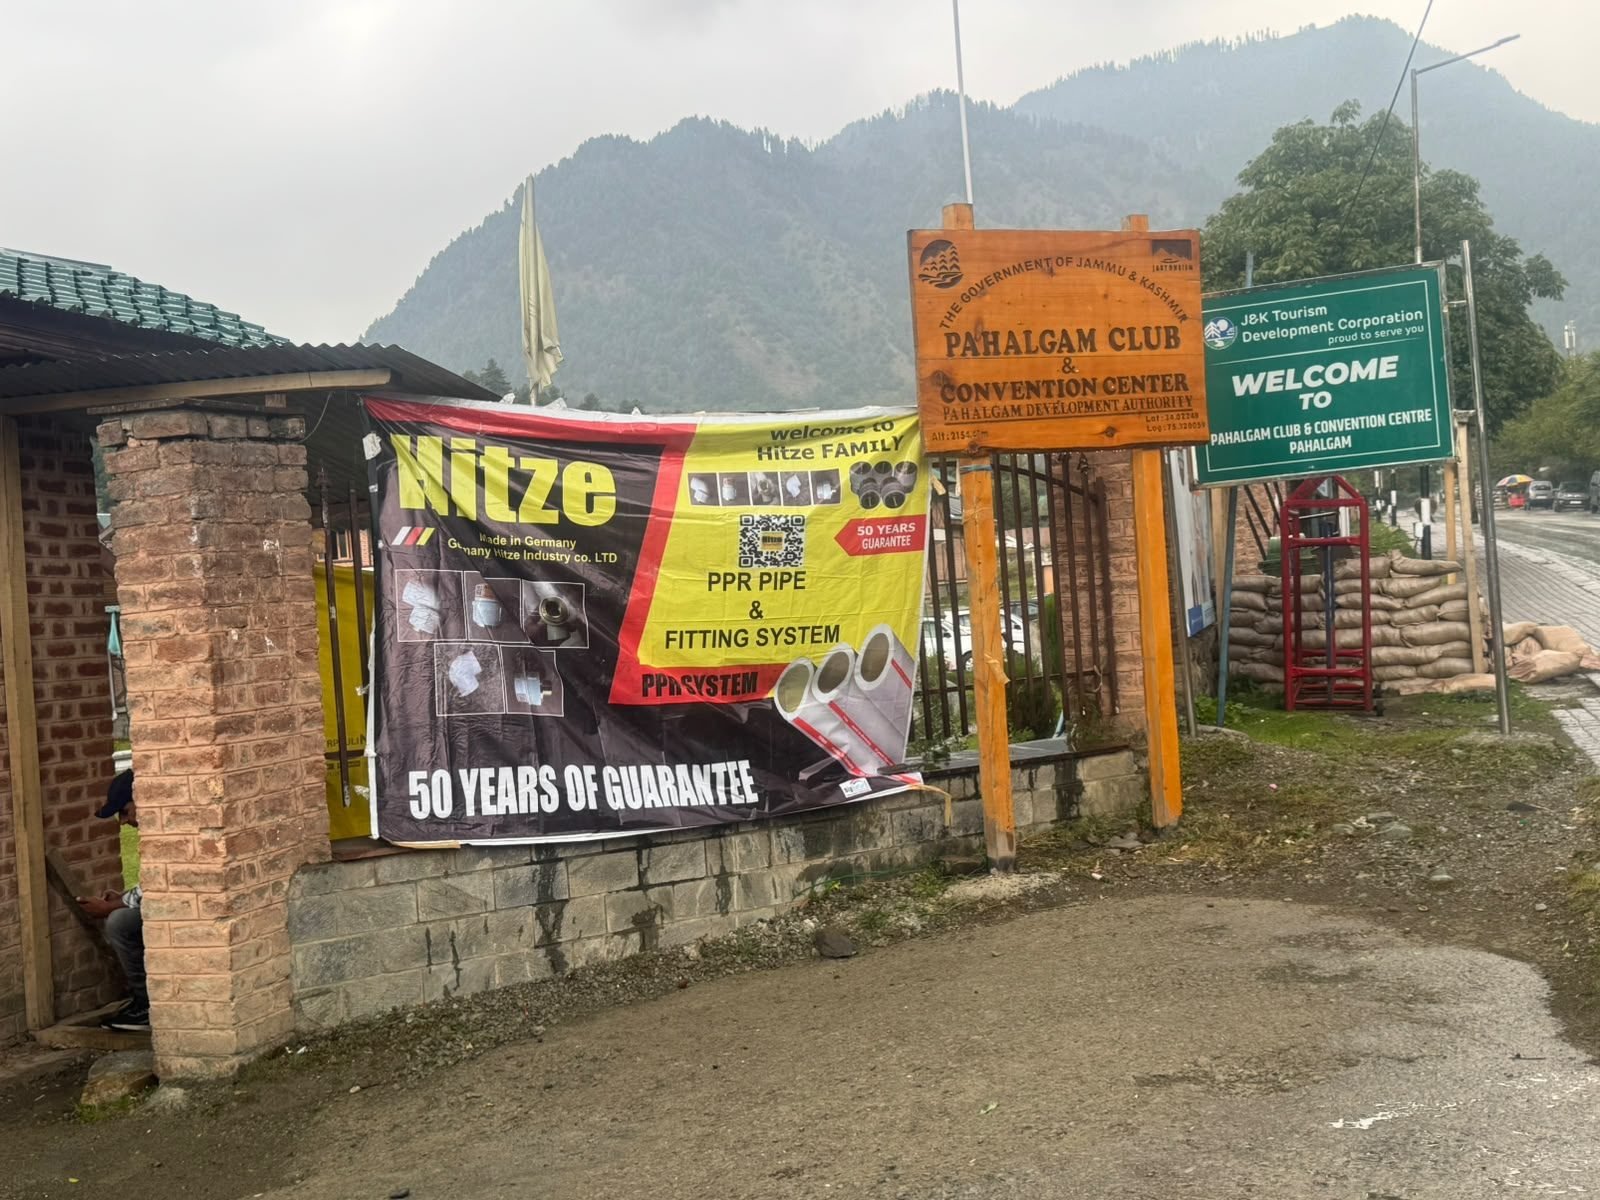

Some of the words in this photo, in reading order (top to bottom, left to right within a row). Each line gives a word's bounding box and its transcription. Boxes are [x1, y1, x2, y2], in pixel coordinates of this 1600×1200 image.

[939, 303, 962, 330] THE
[960, 257, 1053, 303] GOVERNMENT
[1055, 256, 1073, 267] OF
[1076, 257, 1127, 277] JAMMU
[1128, 271, 1137, 281] &
[1139, 276, 1189, 323] KASHMIR
[1241, 311, 1269, 326] J&K
[1272, 305, 1327, 323] Tourism
[1242, 321, 1334, 343] Development
[1338, 310, 1423, 332] Corporation
[943, 328, 1098, 358] PAHALGAM
[1108, 325, 1181, 351] CLUB
[1328, 332, 1358, 346] proud
[1360, 330, 1372, 340] to
[1375, 327, 1402, 339] serve
[1405, 324, 1424, 337] you
[1062, 356, 1076, 374] &
[1232, 355, 1399, 397] WELCOME
[940, 378, 1098, 403] CONVENTION
[1103, 373, 1189, 395] CENTER
[943, 405, 1022, 421] PAHALGAM
[1027, 399, 1119, 417] DEVELOPMENT
[1123, 395, 1193, 410] AUTHORITY
[1299, 391, 1332, 410] TO
[771, 421, 865, 441] welcome
[873, 419, 895, 432] to
[1210, 427, 1271, 446] PAHALGAM
[1273, 423, 1301, 439] CLUB
[1304, 422, 1311, 434] &
[1314, 414, 1386, 434] CONVENTION
[1388, 408, 1432, 426] CENTRE
[757, 446, 815, 461] Hitze
[822, 435, 905, 460] FAMILY
[1289, 435, 1352, 454] PAHALGAM
[390, 434, 617, 526] Hitze
[857, 525, 874, 536] 50
[877, 522, 916, 534] YEARS
[480, 533, 507, 545] Made
[510, 535, 521, 545] in
[524, 536, 576, 550] Germany
[862, 536, 911, 550] GUARANTEE
[494, 550, 520, 560] Hitze
[524, 550, 570, 564] Industry
[574, 554, 591, 563] co.
[595, 553, 617, 563] LTD
[707, 571, 752, 592] PPR
[758, 570, 807, 591] PIPE
[748, 600, 764, 619] &
[665, 628, 750, 650] FITTING
[756, 624, 840, 647] SYSTEM
[681, 671, 759, 697] SYSTEM
[408, 769, 453, 820] 50
[459, 765, 560, 816] YEARS
[564, 764, 599, 811] OF
[602, 760, 759, 810] GUARANTEE
